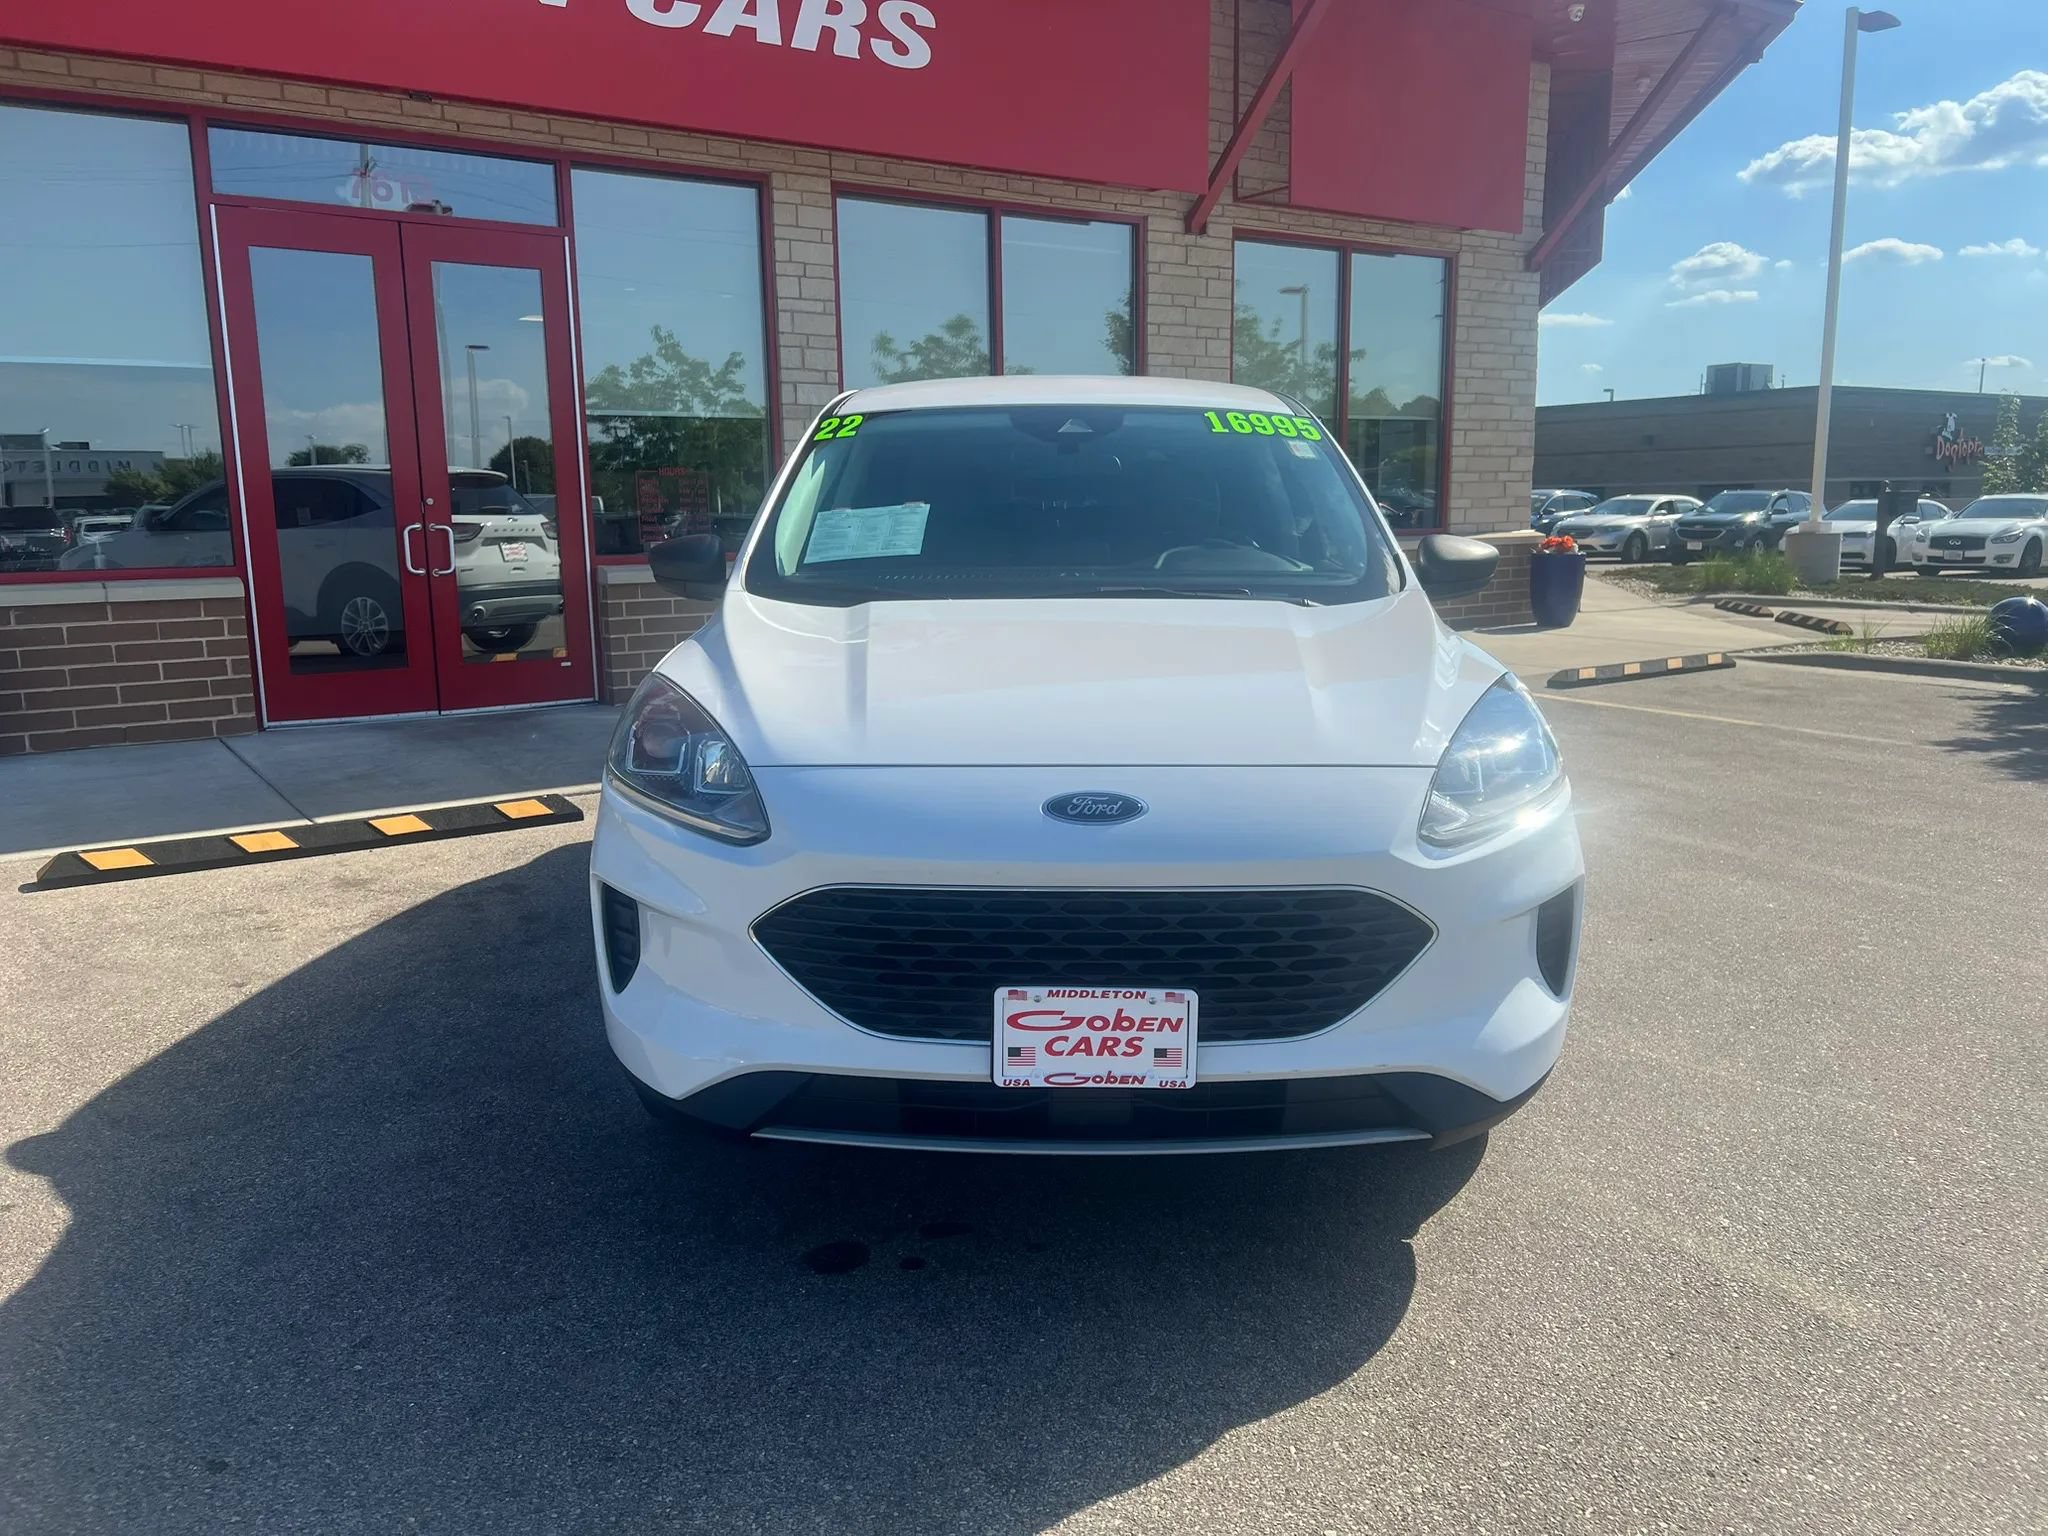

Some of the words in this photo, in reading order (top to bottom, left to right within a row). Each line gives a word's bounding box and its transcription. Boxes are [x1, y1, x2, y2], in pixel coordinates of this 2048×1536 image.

[813, 414, 864, 441] 22
[1204, 411, 1322, 441] 16995
[1067, 796, 1122, 815] Ford
[1047, 989, 1147, 1000] MIDDLETON
[1044, 1035, 1145, 1057] CARS
[1002, 1078, 1031, 1088] USA
[1159, 1080, 1187, 1089] USA
